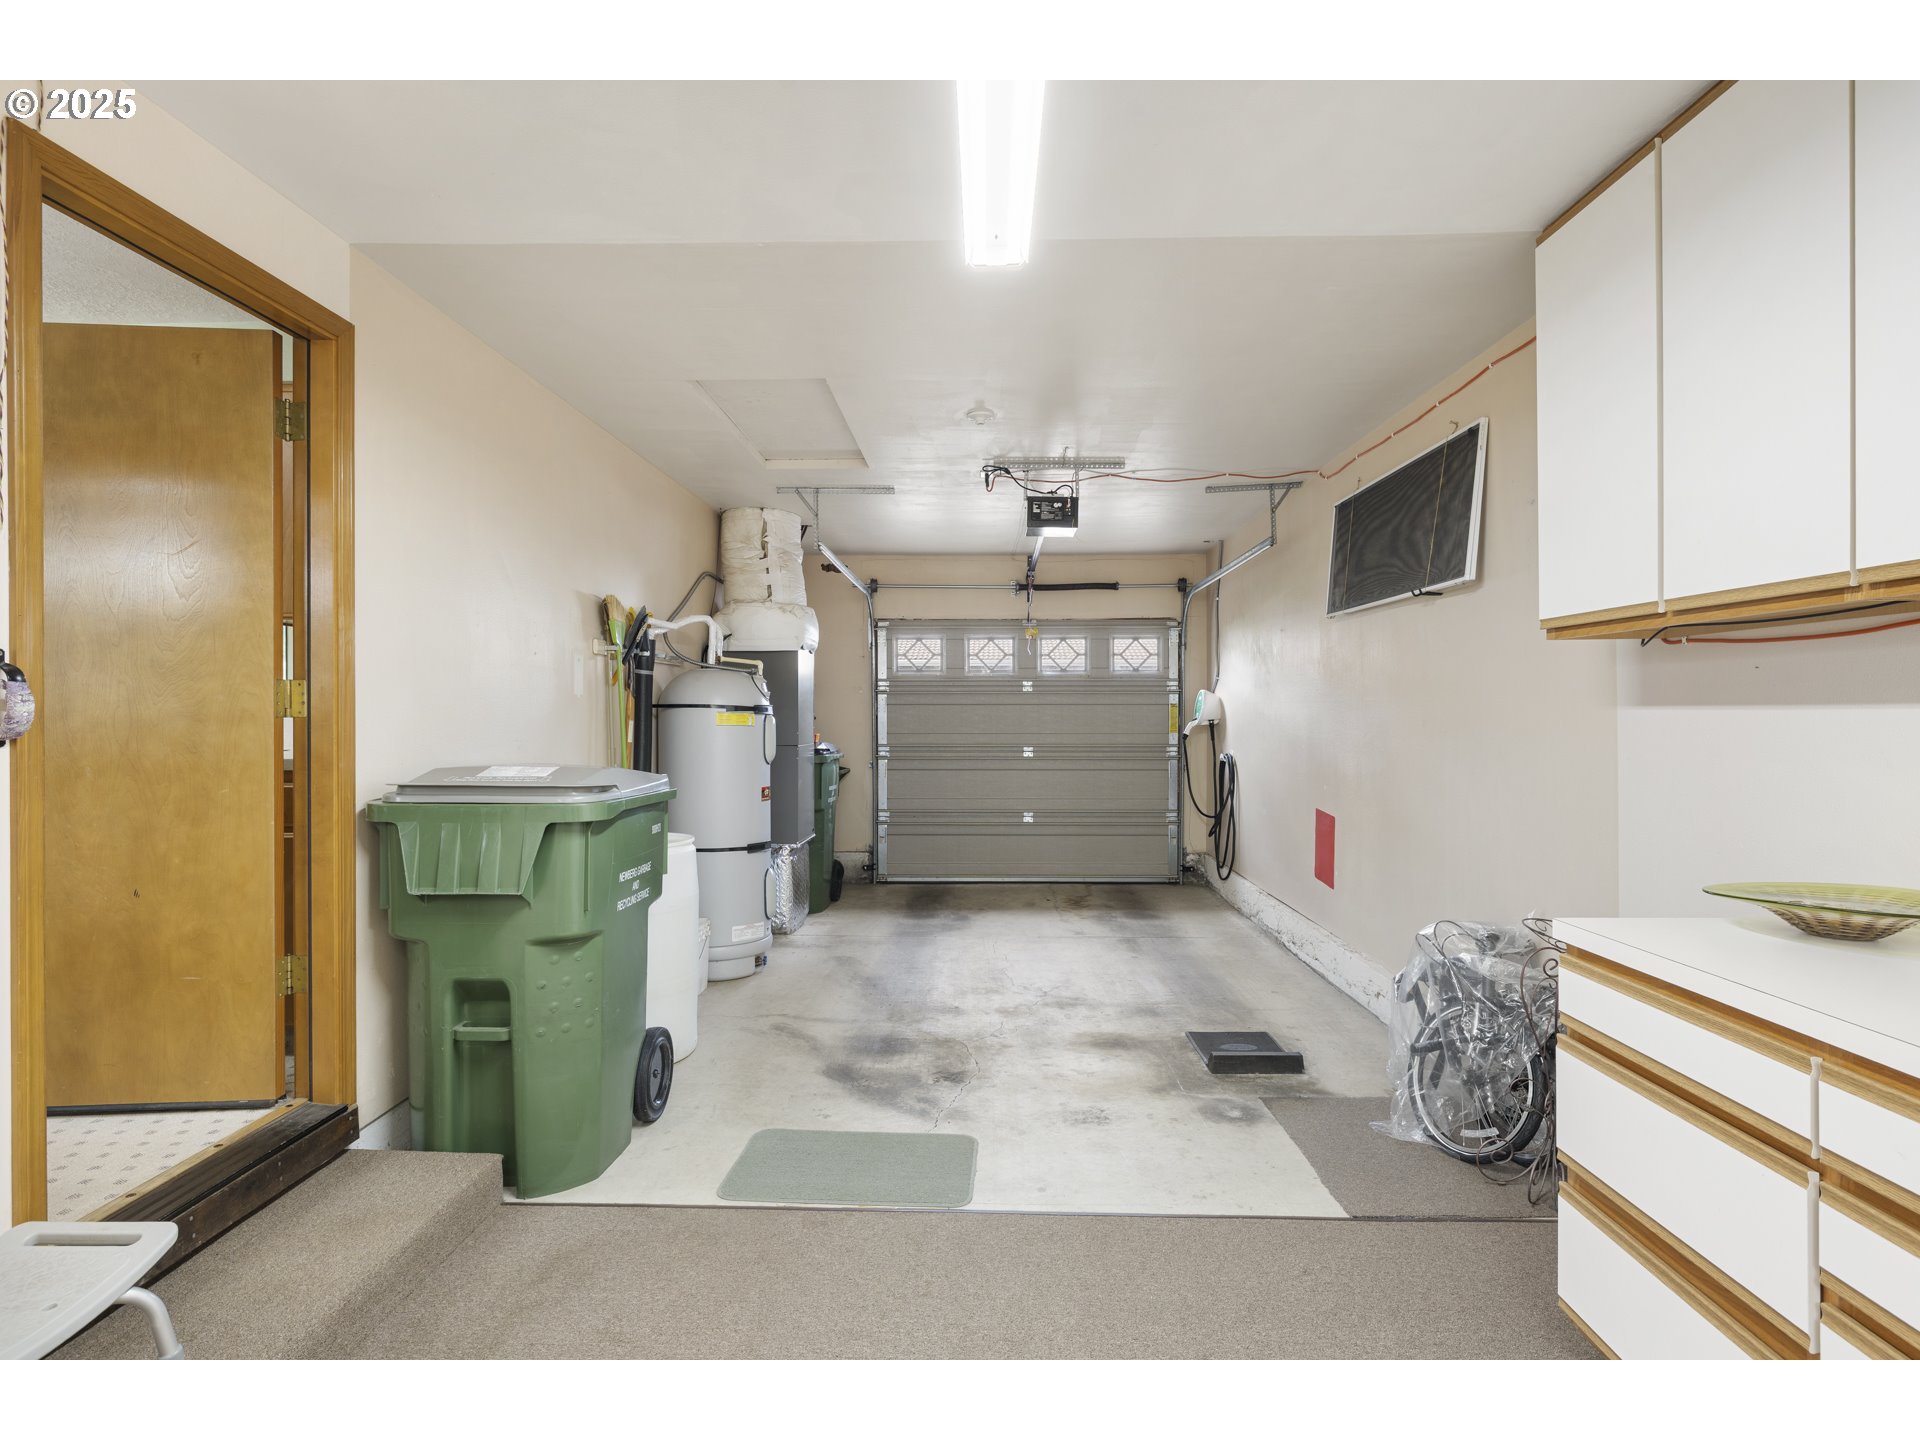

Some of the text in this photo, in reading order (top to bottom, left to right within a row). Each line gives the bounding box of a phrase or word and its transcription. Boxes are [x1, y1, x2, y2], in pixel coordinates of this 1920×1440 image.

[619, 861, 652, 882] NEWBERG GARBAGE
[632, 879, 640, 891] AND
[617, 887, 650, 911] RECYCLING SERVICE
